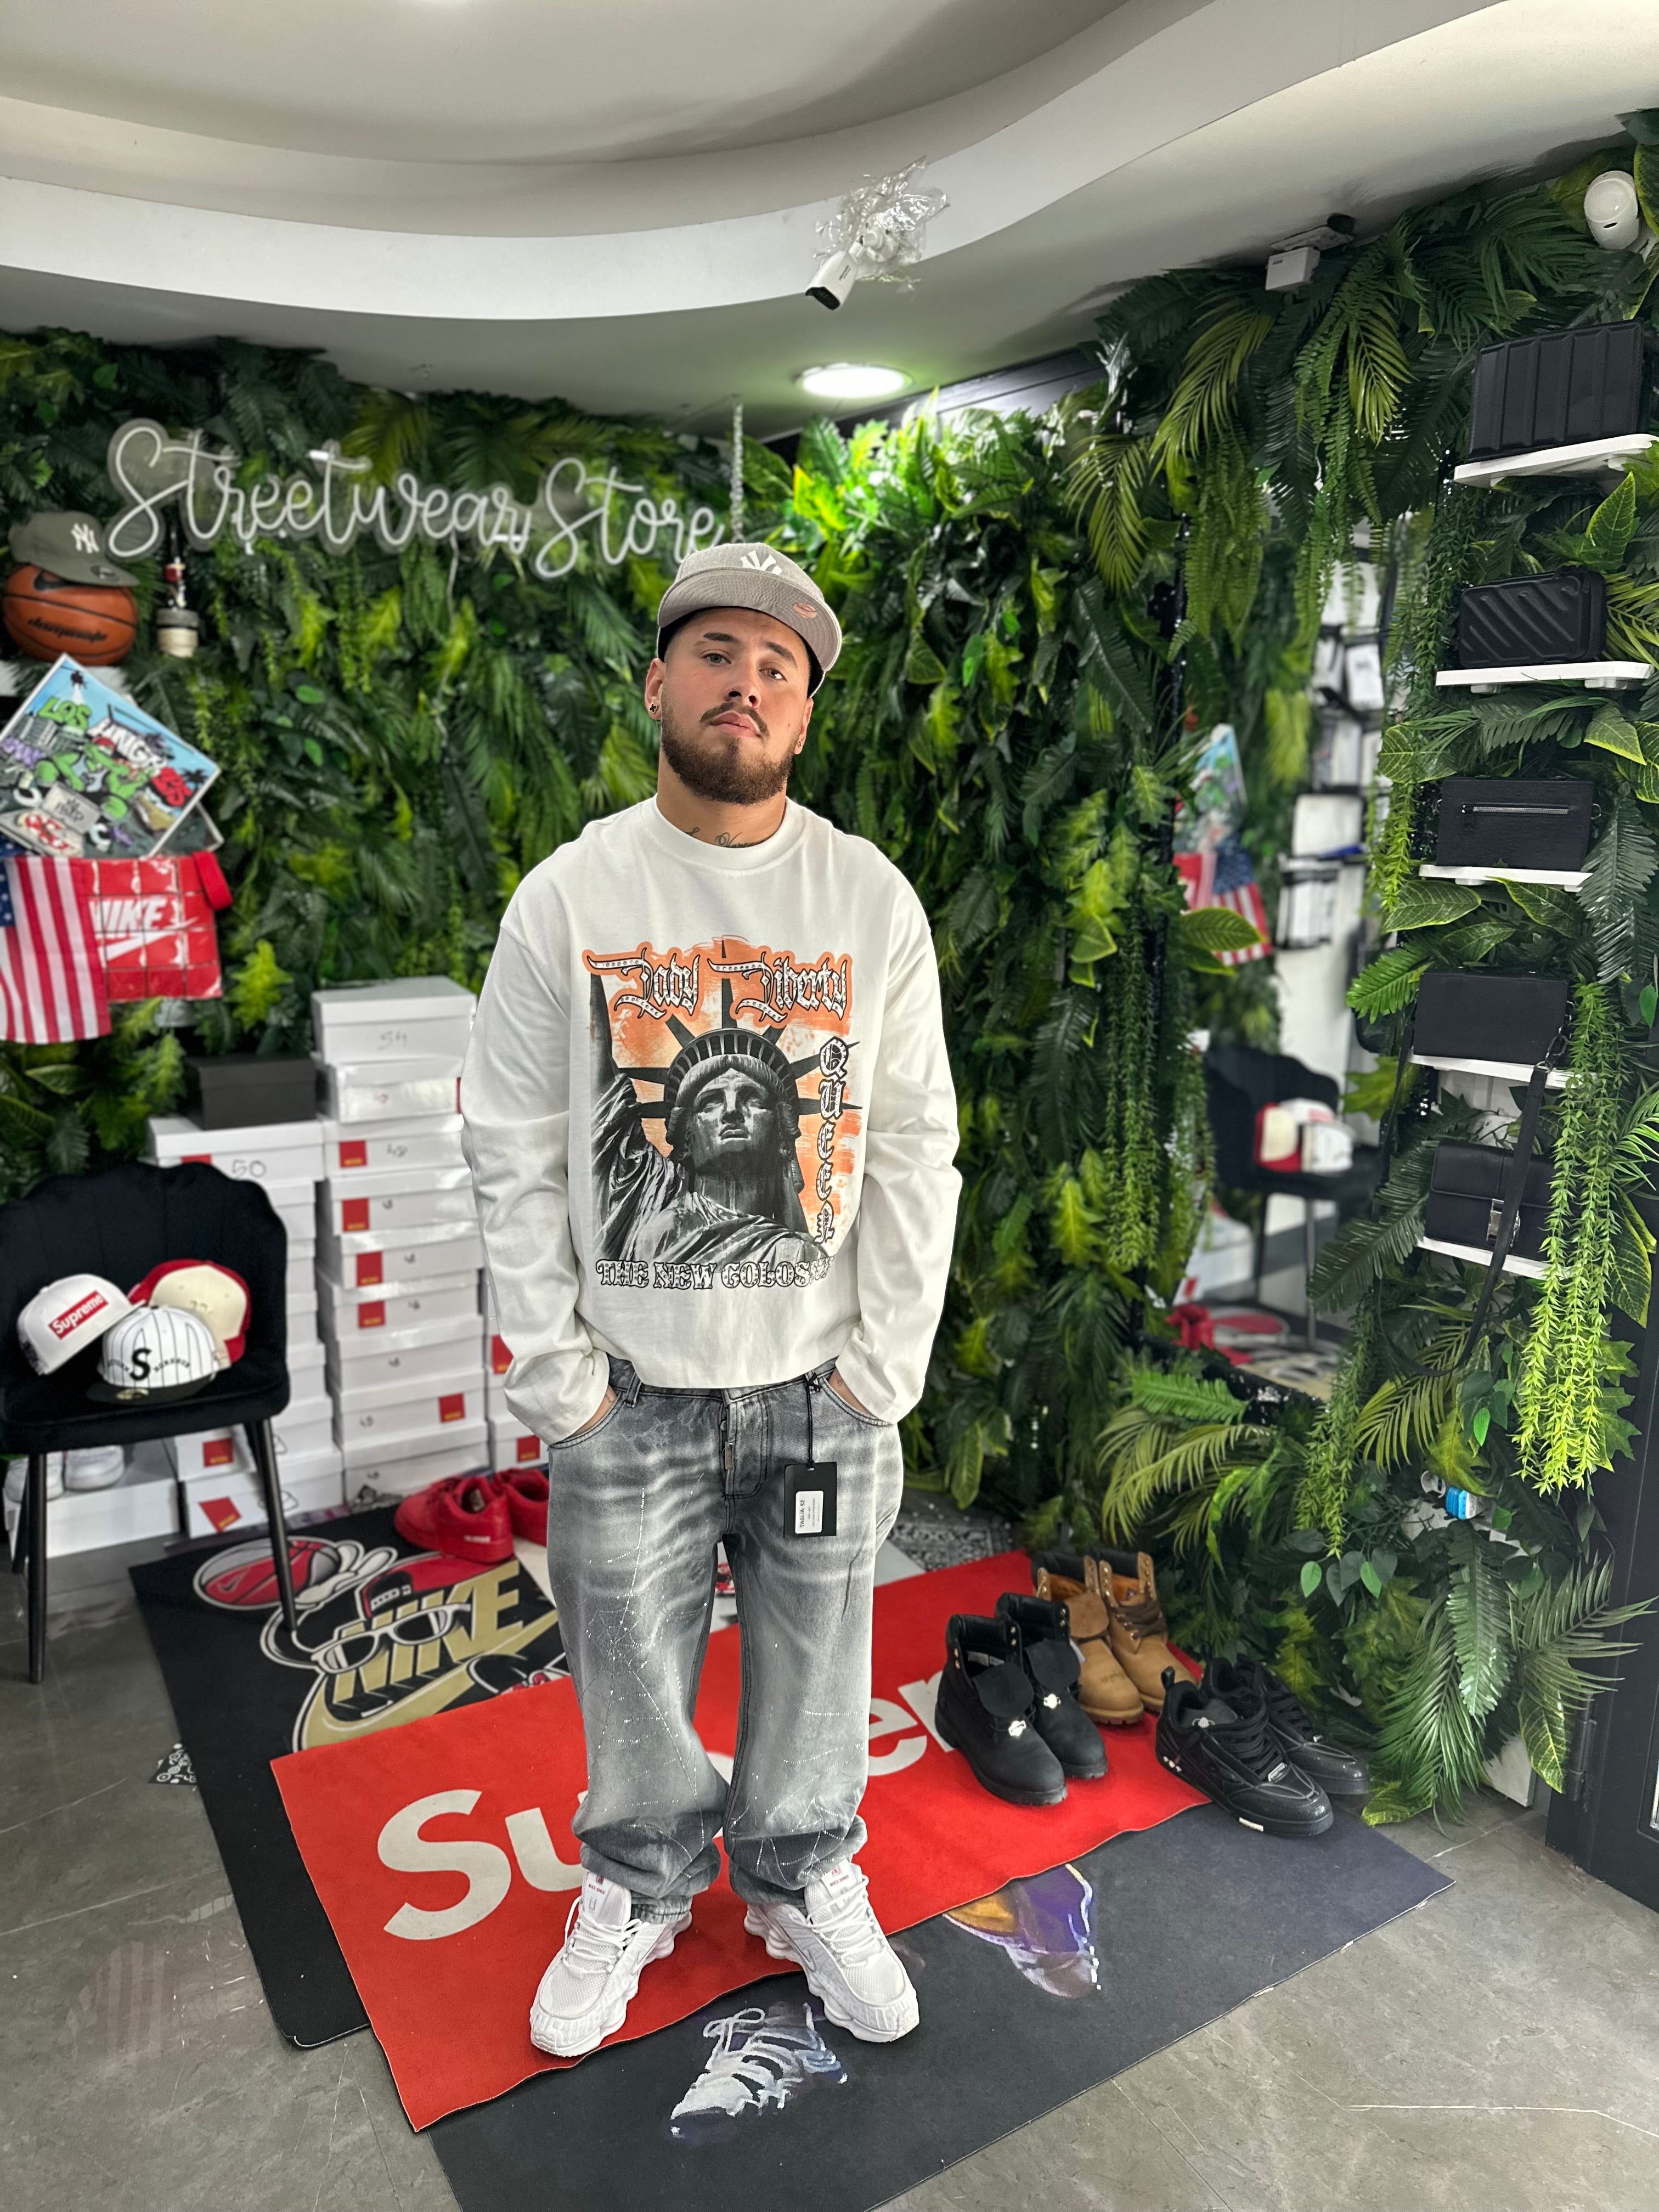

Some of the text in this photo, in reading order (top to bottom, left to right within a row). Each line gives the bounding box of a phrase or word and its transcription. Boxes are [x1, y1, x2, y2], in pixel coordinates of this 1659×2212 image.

[108, 426, 529, 558] Streetwear
[586, 947, 848, 1023] Lady Liberty
[231, 1158, 267, 1179] 50
[595, 1259, 650, 1288] THE
[653, 1262, 717, 1290] NEW
[52, 1293, 106, 1335] Supreme
[129, 1347, 153, 1381] S
